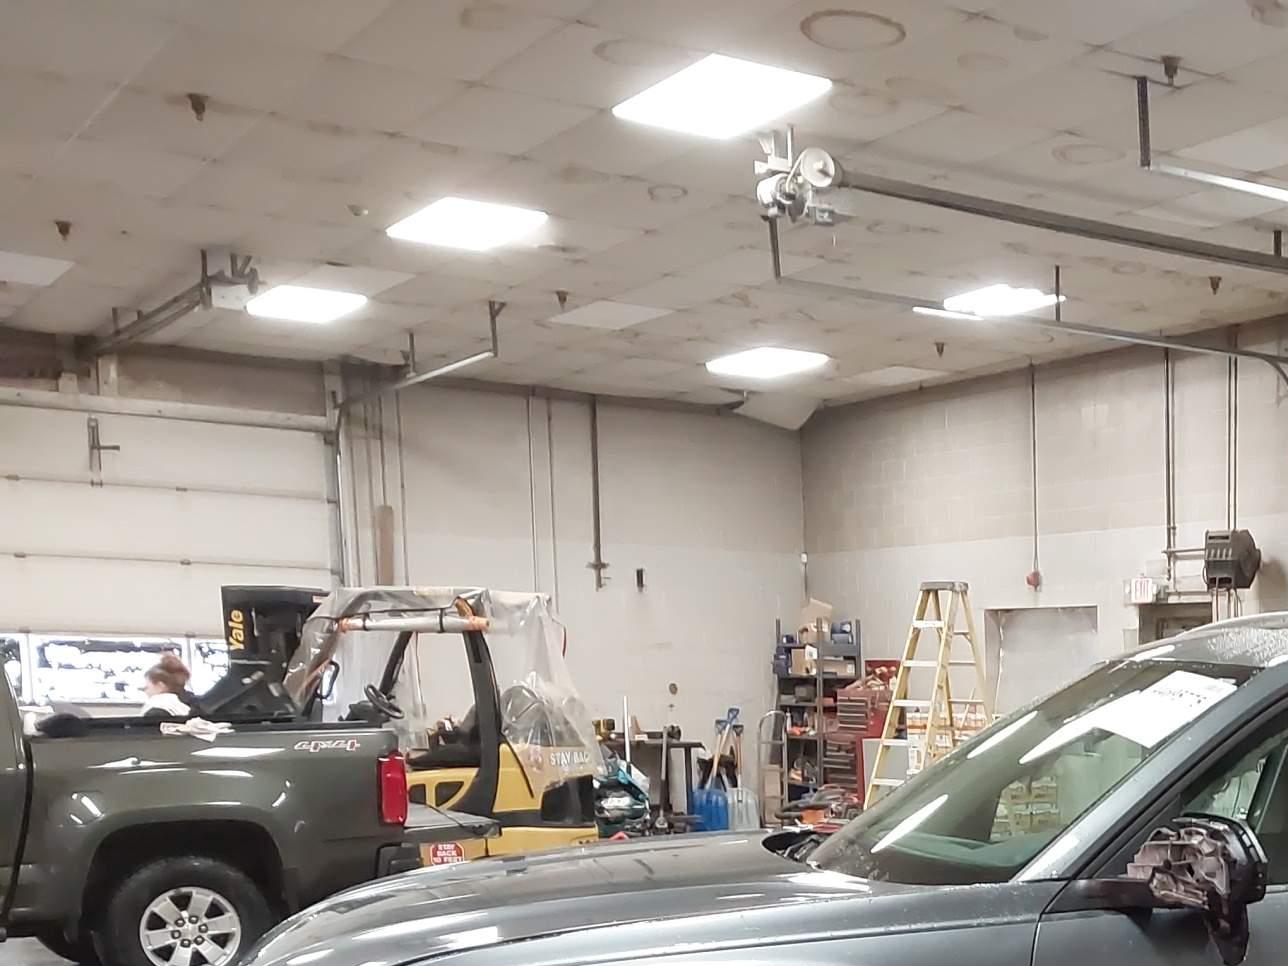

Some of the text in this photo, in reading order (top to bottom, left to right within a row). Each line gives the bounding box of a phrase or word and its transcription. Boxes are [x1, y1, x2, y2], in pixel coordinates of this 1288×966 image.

[228, 609, 245, 650] Yale
[550, 751, 571, 766] STAY
[437, 843, 456, 851] STAY
